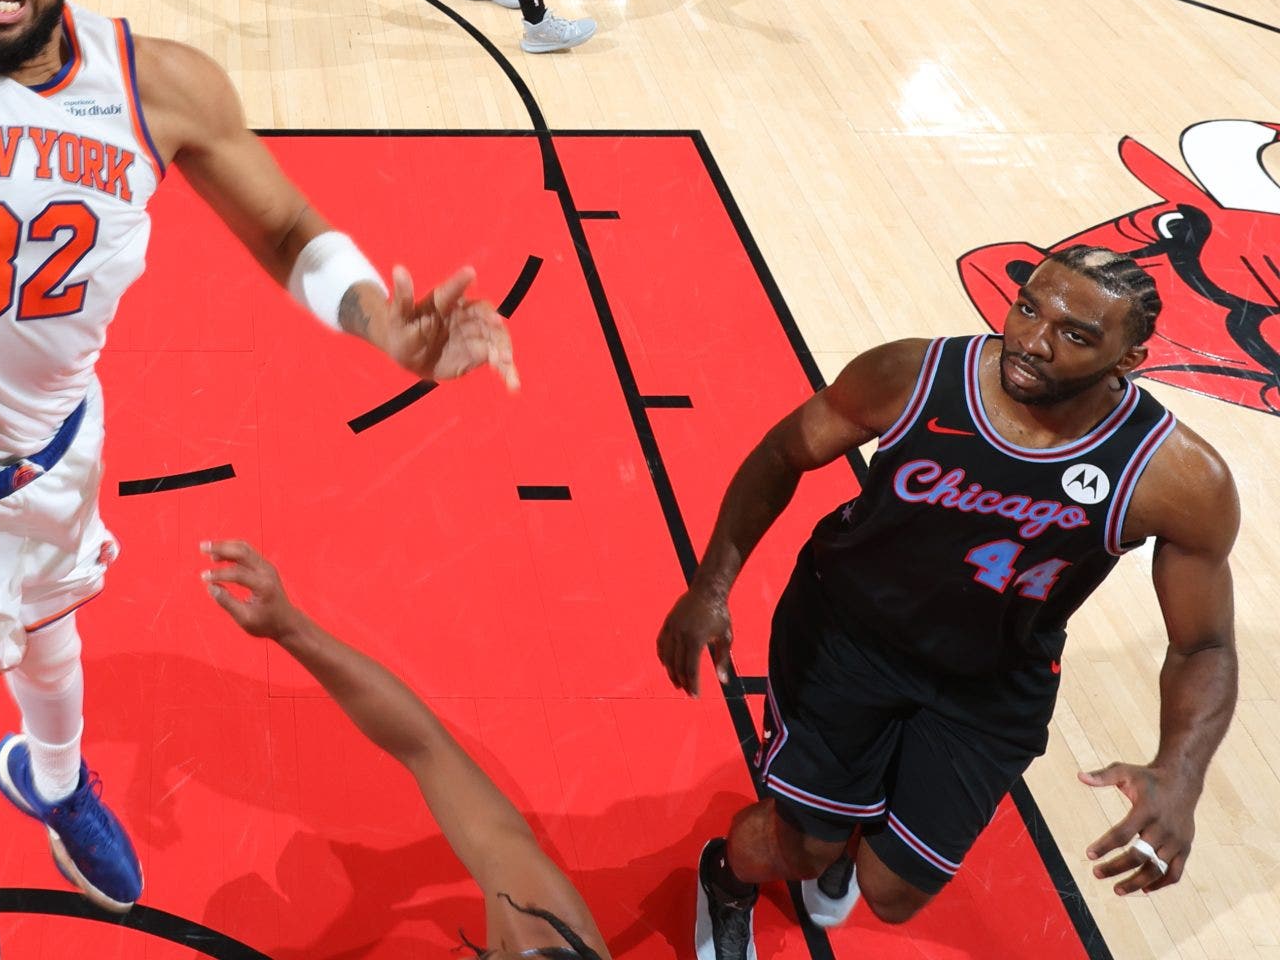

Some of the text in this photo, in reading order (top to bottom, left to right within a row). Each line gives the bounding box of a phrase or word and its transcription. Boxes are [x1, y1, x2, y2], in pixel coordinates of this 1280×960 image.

[88, 103, 122, 116] dhabi
[25, 126, 135, 205] YORK
[893, 459, 1090, 539] Chicago
[963, 539, 1073, 601] 44
